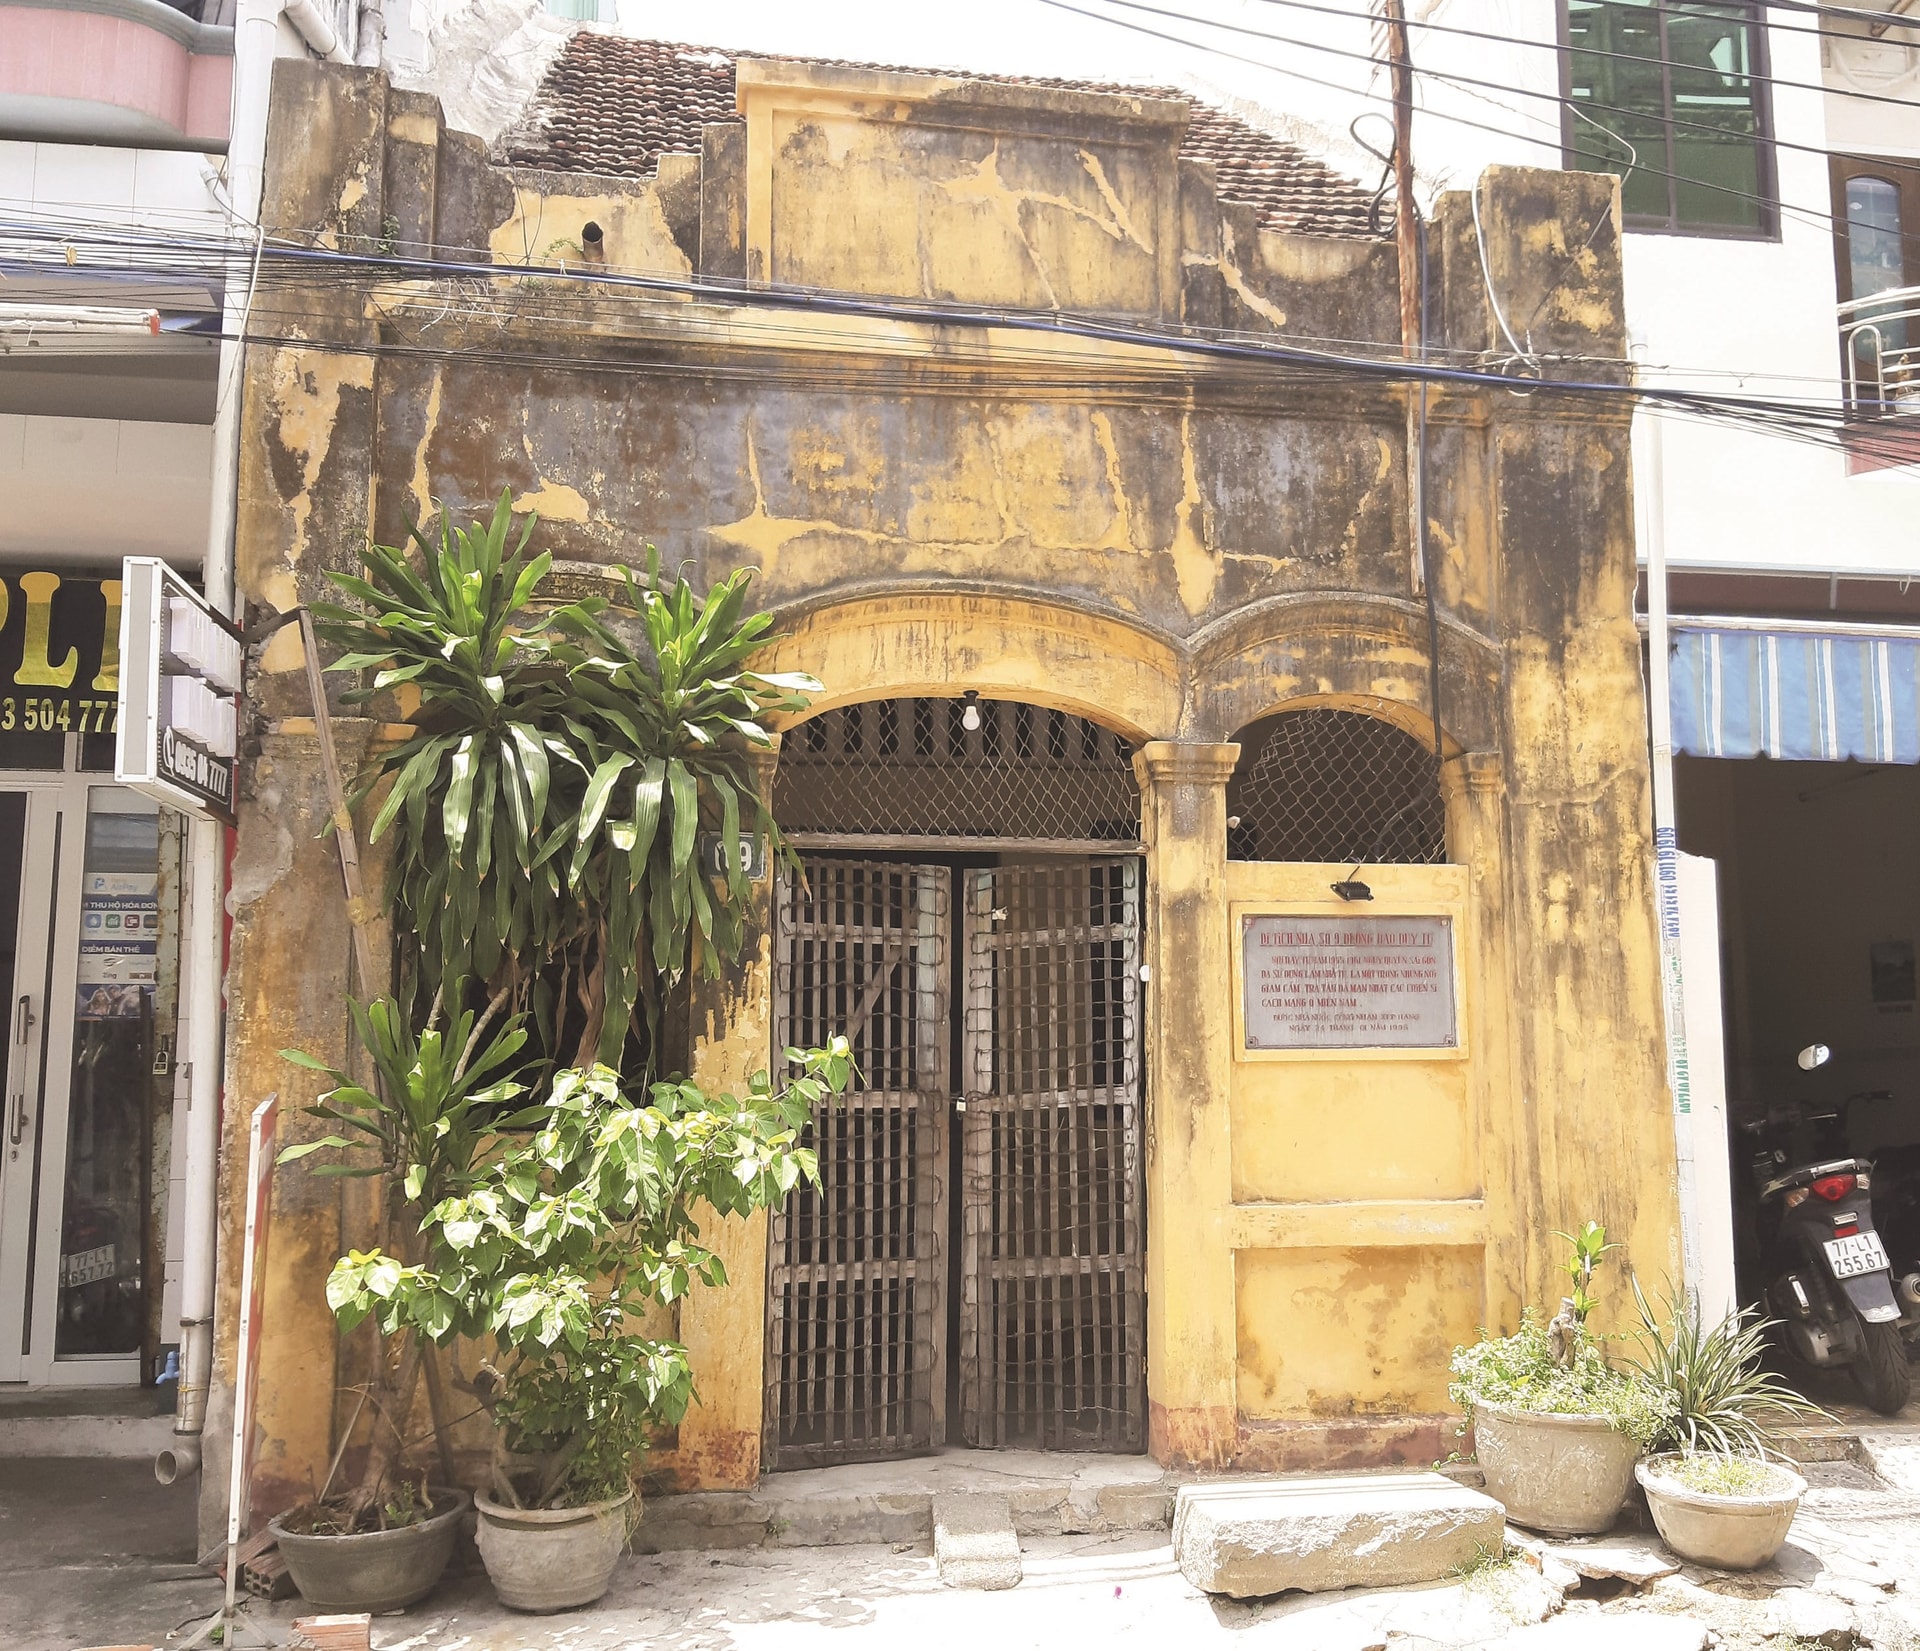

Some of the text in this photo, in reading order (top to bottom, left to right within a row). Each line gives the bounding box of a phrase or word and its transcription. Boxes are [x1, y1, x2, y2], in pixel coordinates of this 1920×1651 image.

[24, 698, 71, 731] 504
[90, 901, 108, 909] THU
[108, 900, 121, 911] HỘ
[121, 901, 140, 909] HÓA
[1334, 932, 1340, 945] 9
[104, 944, 123, 953] BÁN
[1831, 1235, 1873, 1257] 77-L1
[1834, 1251, 1884, 1276] 255.67
